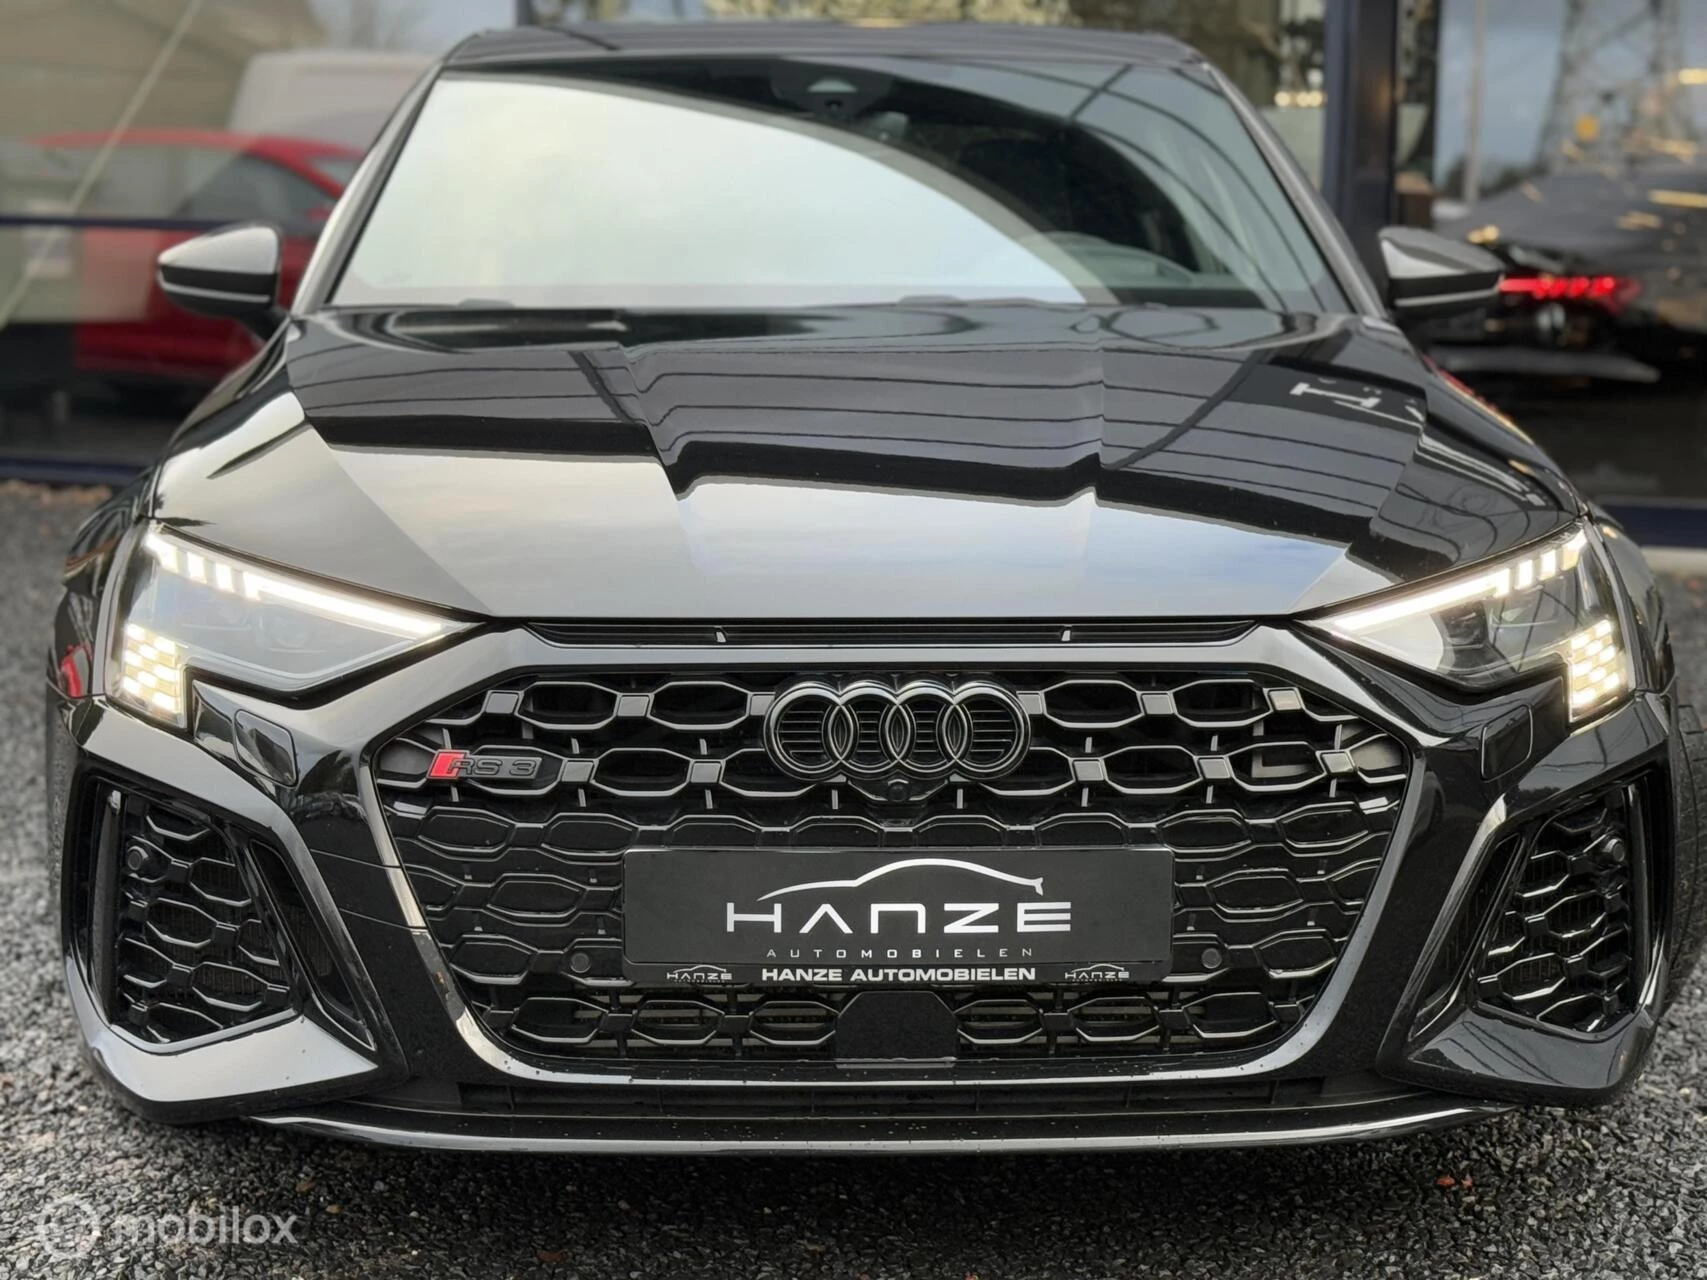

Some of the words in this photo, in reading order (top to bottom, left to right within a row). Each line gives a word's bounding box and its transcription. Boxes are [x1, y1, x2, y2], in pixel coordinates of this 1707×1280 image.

[726, 902, 1072, 934] HANZE
[766, 948, 1033, 959] AUTOMOBIELEN
[666, 972, 733, 980] HANZE
[761, 968, 843, 982] HANZE
[850, 967, 1036, 982] AUTOMOBIELEN
[1064, 971, 1130, 980] HANZE
